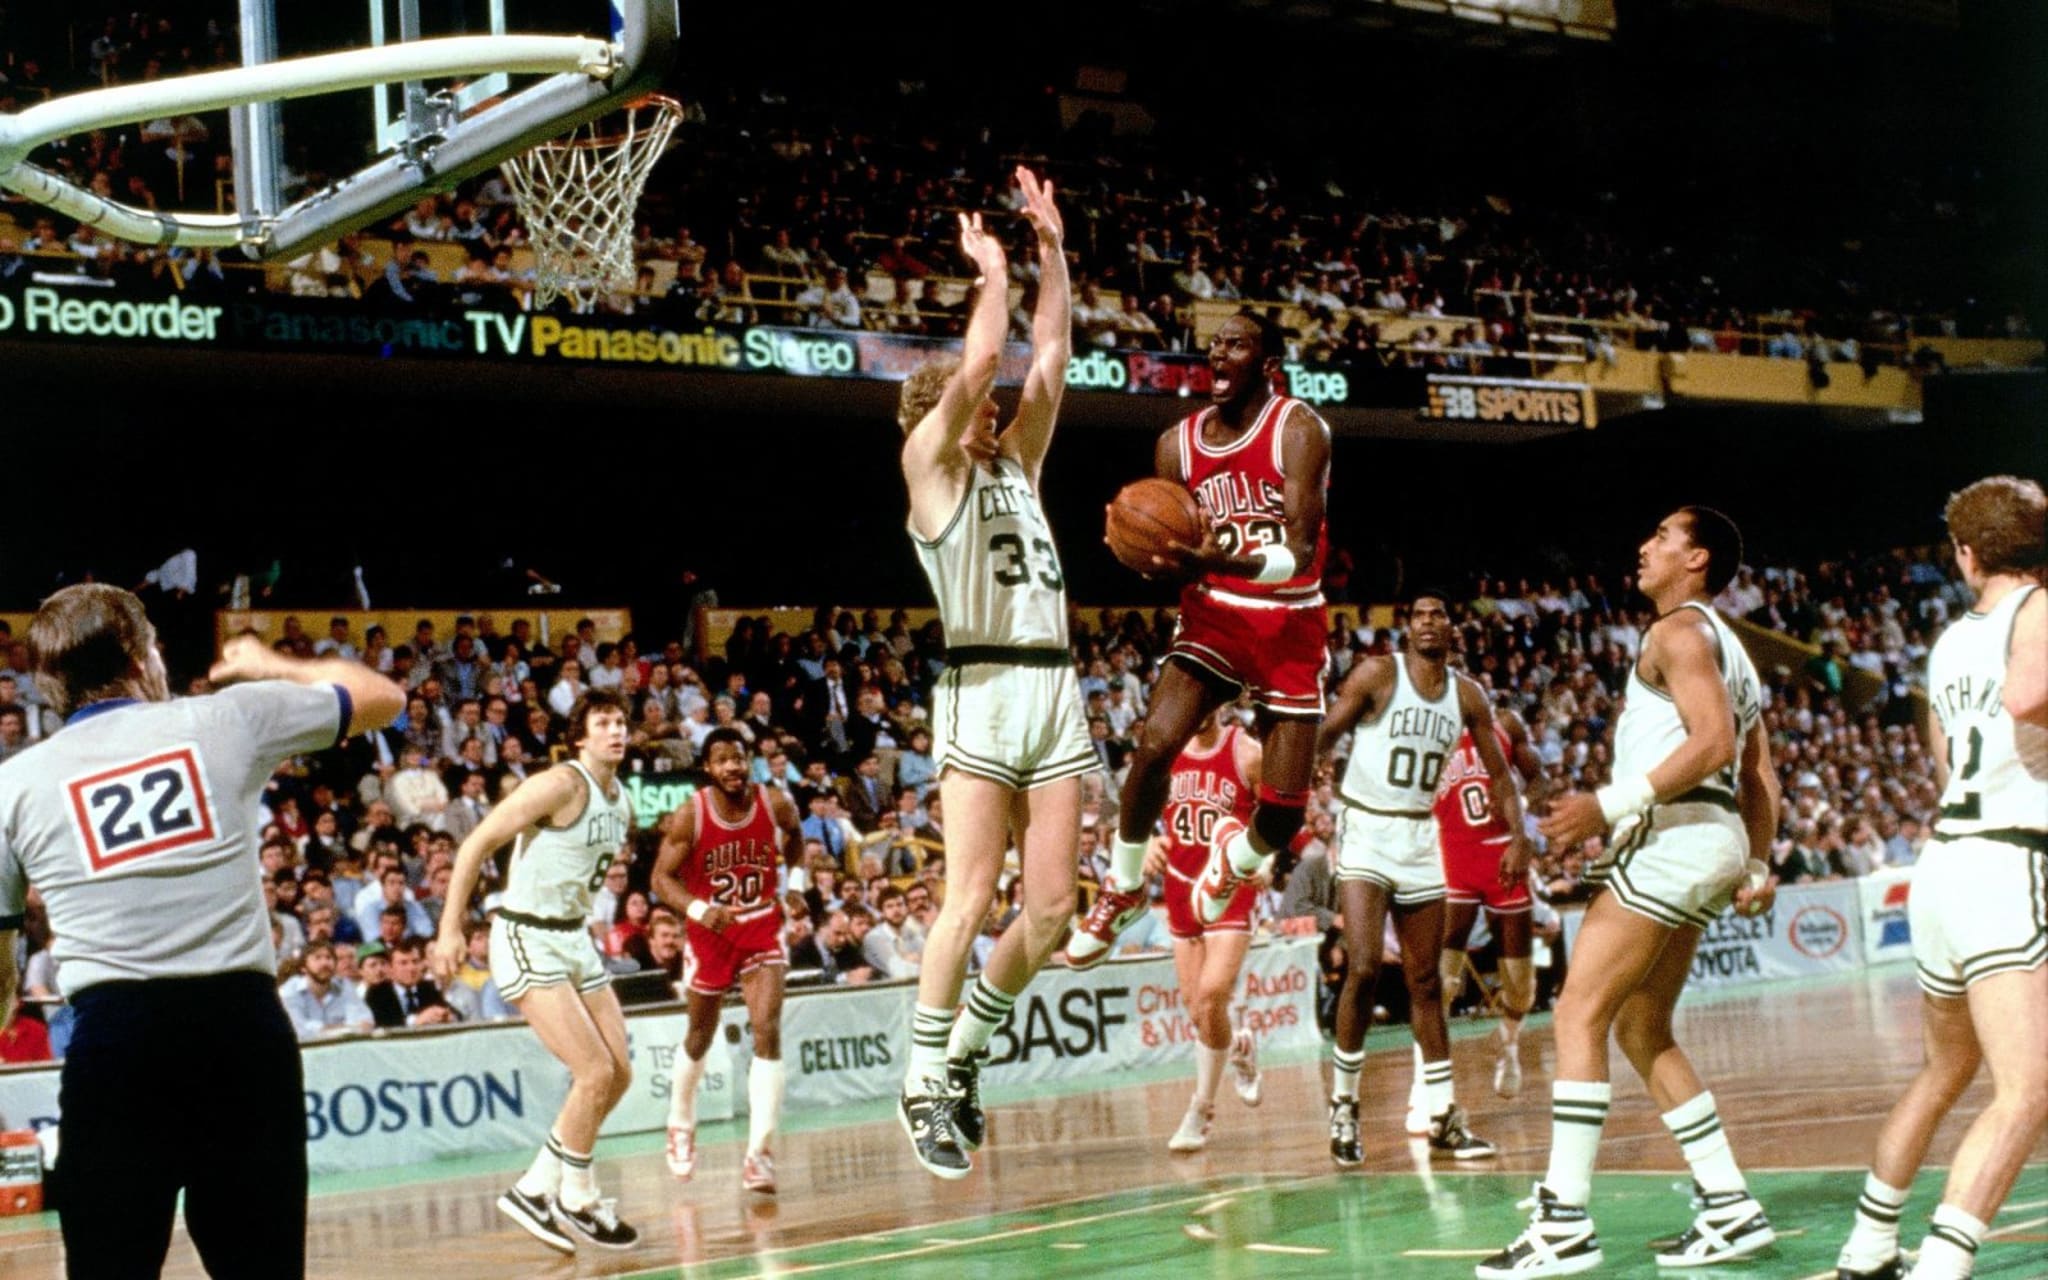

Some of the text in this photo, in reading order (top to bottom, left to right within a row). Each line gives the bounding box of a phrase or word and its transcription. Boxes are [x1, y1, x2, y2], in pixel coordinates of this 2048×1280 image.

[24, 286, 223, 341] Recorder
[464, 310, 527, 354] TV
[530, 315, 741, 367] Panasonic
[744, 329, 856, 371] Stereo
[1065, 352, 1126, 388] adio
[1283, 363, 1348, 406] Tape
[1477, 387, 1581, 425] SPORTS
[989, 533, 1063, 592] 33
[1389, 706, 1456, 748] CELTICS
[1387, 745, 1445, 792] 00
[90, 767, 194, 850] 22
[1172, 803, 1221, 846] 40
[710, 871, 764, 908] 20
[1690, 945, 1761, 980] OYOTA
[1141, 1018, 1159, 1047] &
[1235, 1003, 1299, 1038] Tapes
[801, 1032, 891, 1075] CELTICS
[304, 1069, 525, 1141] BOSTON
